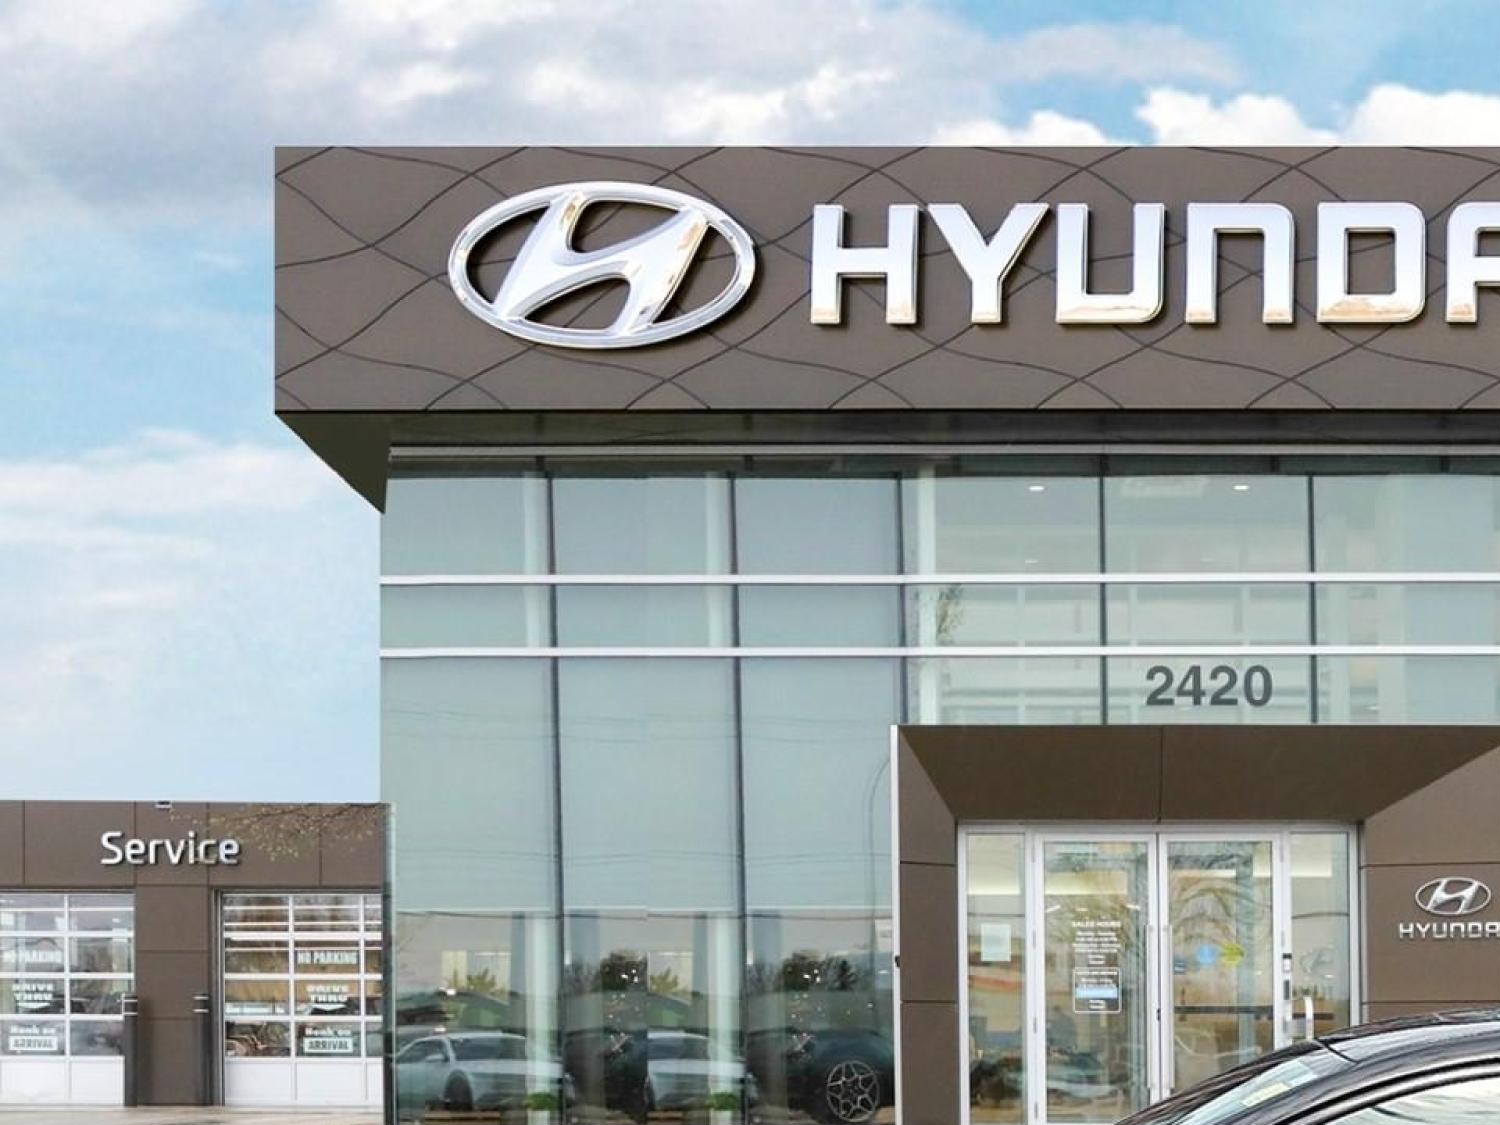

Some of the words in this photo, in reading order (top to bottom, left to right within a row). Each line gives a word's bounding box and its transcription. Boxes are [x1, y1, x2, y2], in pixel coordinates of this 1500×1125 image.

[1146, 664, 1273, 707] 2420
[100, 830, 240, 865] Service
[308, 1039, 350, 1050] ARRIVAL
